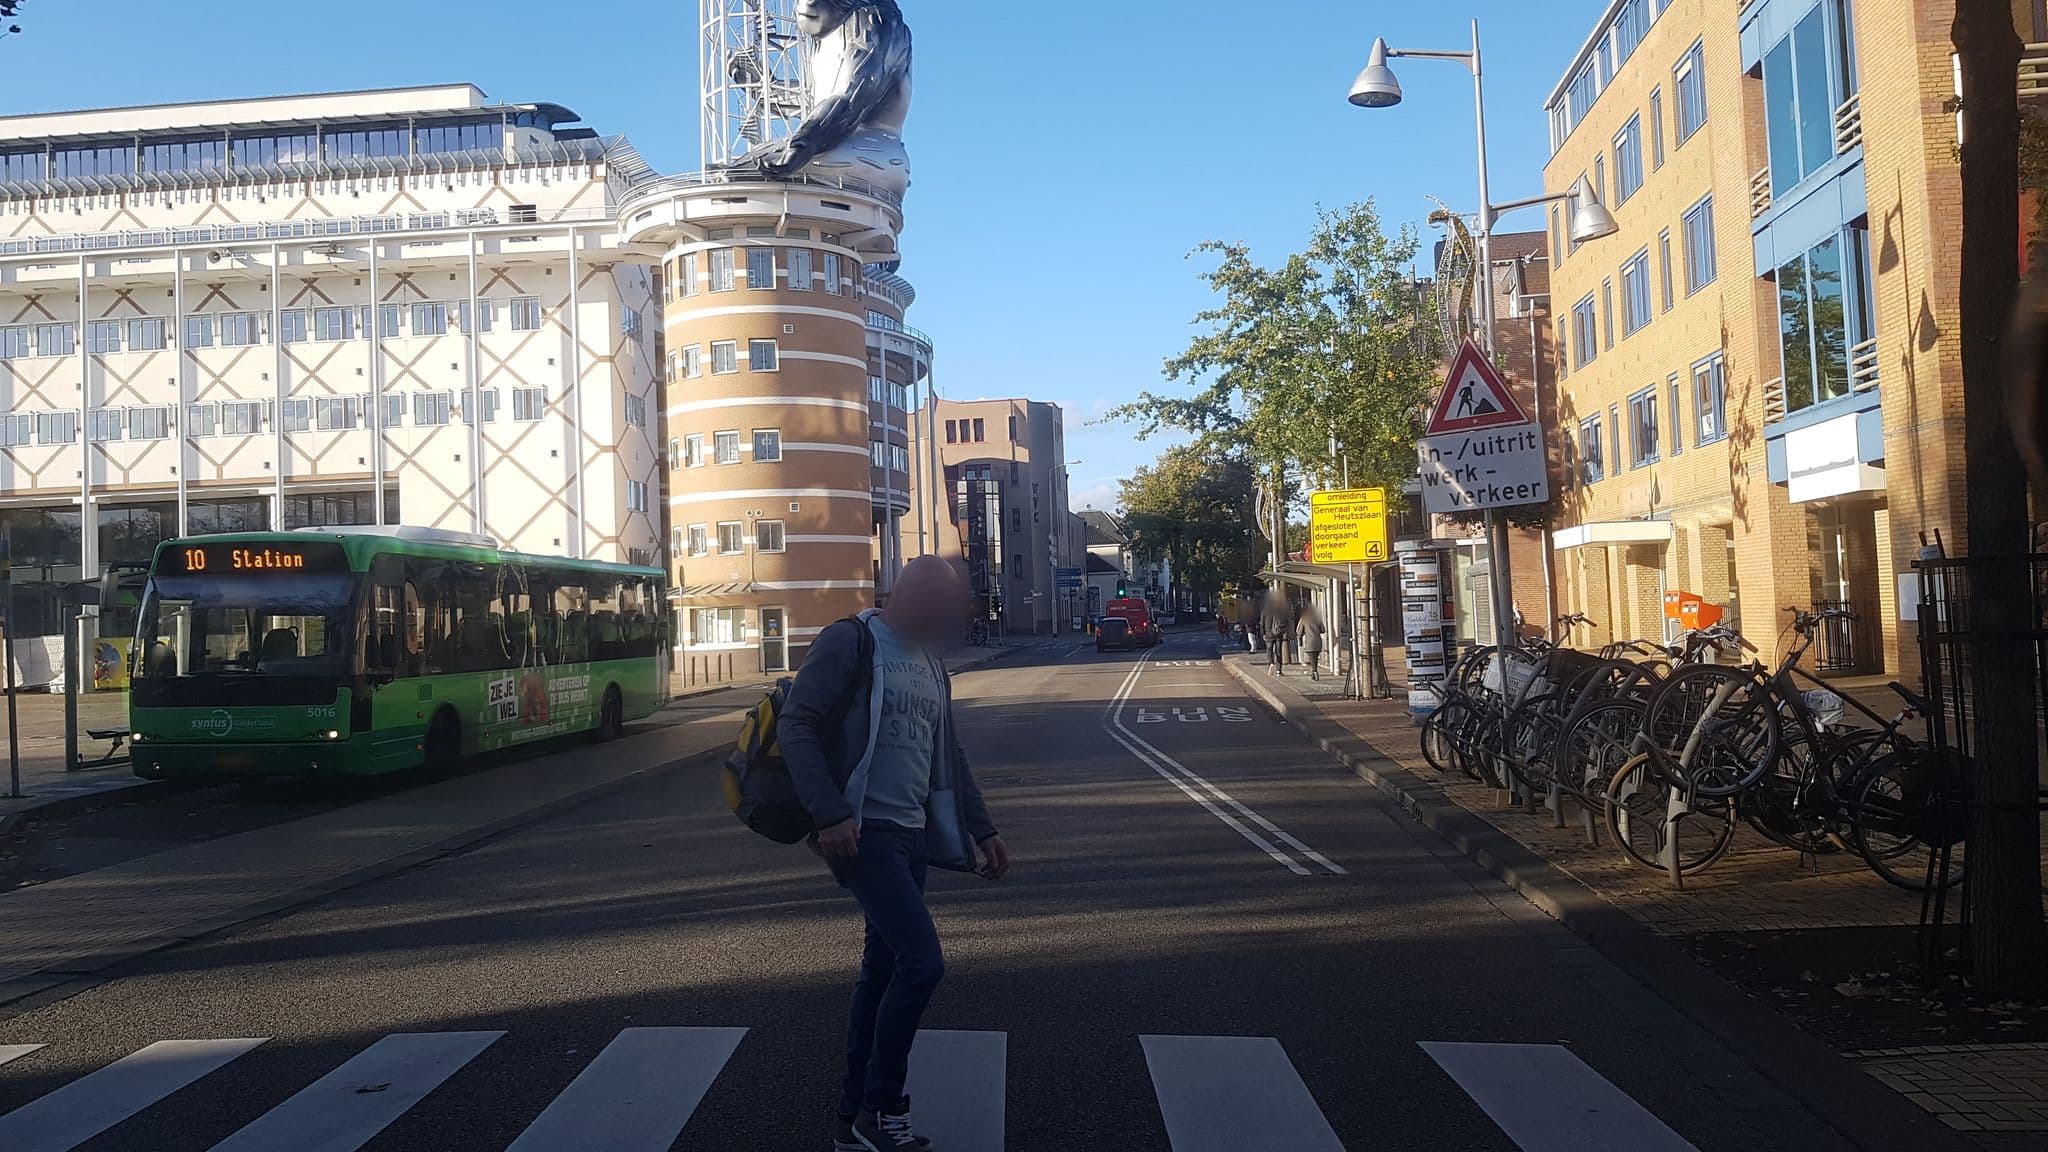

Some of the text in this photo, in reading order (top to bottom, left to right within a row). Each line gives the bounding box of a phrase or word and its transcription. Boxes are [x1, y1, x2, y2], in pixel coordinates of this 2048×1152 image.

[1424, 463, 1479, 487] werk
[1327, 492, 1367, 501] omleiding
[1449, 482, 1541, 506] verkeer
[1313, 505, 1350, 514] Generaal
[1334, 512, 1382, 520] Heutszlaan
[1314, 522, 1357, 533] afgesloten
[1314, 532, 1359, 541] doorgaand
[1315, 541, 1346, 549] verkeer
[1368, 543, 1380, 555] 4
[185, 549, 303, 570] 10 Station
[1315, 551, 1333, 560] volg
[490, 680, 513, 702] ZIE JE
[307, 707, 336, 718] 5016
[500, 700, 517, 719] WEL
[191, 717, 227, 730] syntus
